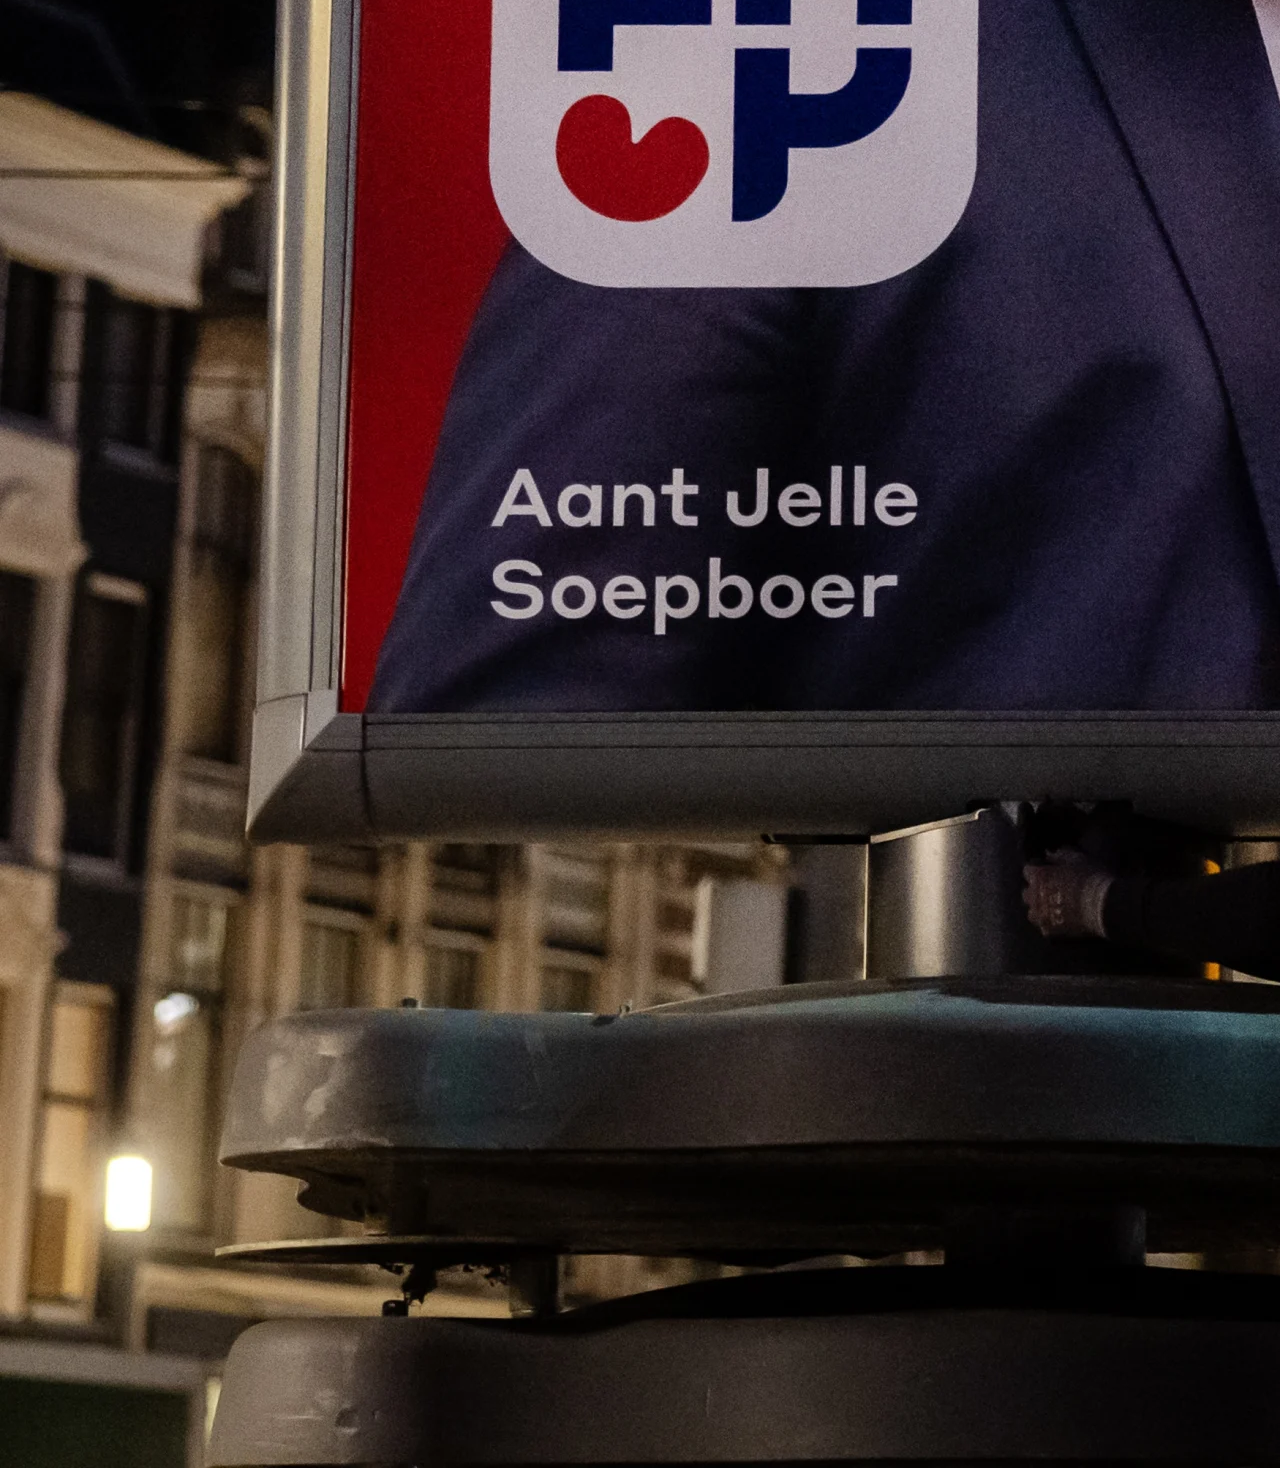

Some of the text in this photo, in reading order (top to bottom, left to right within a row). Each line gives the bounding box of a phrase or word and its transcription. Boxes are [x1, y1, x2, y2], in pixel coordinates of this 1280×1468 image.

[490, 465, 919, 528] Aant Jelle
[489, 557, 899, 636] Soepboer
